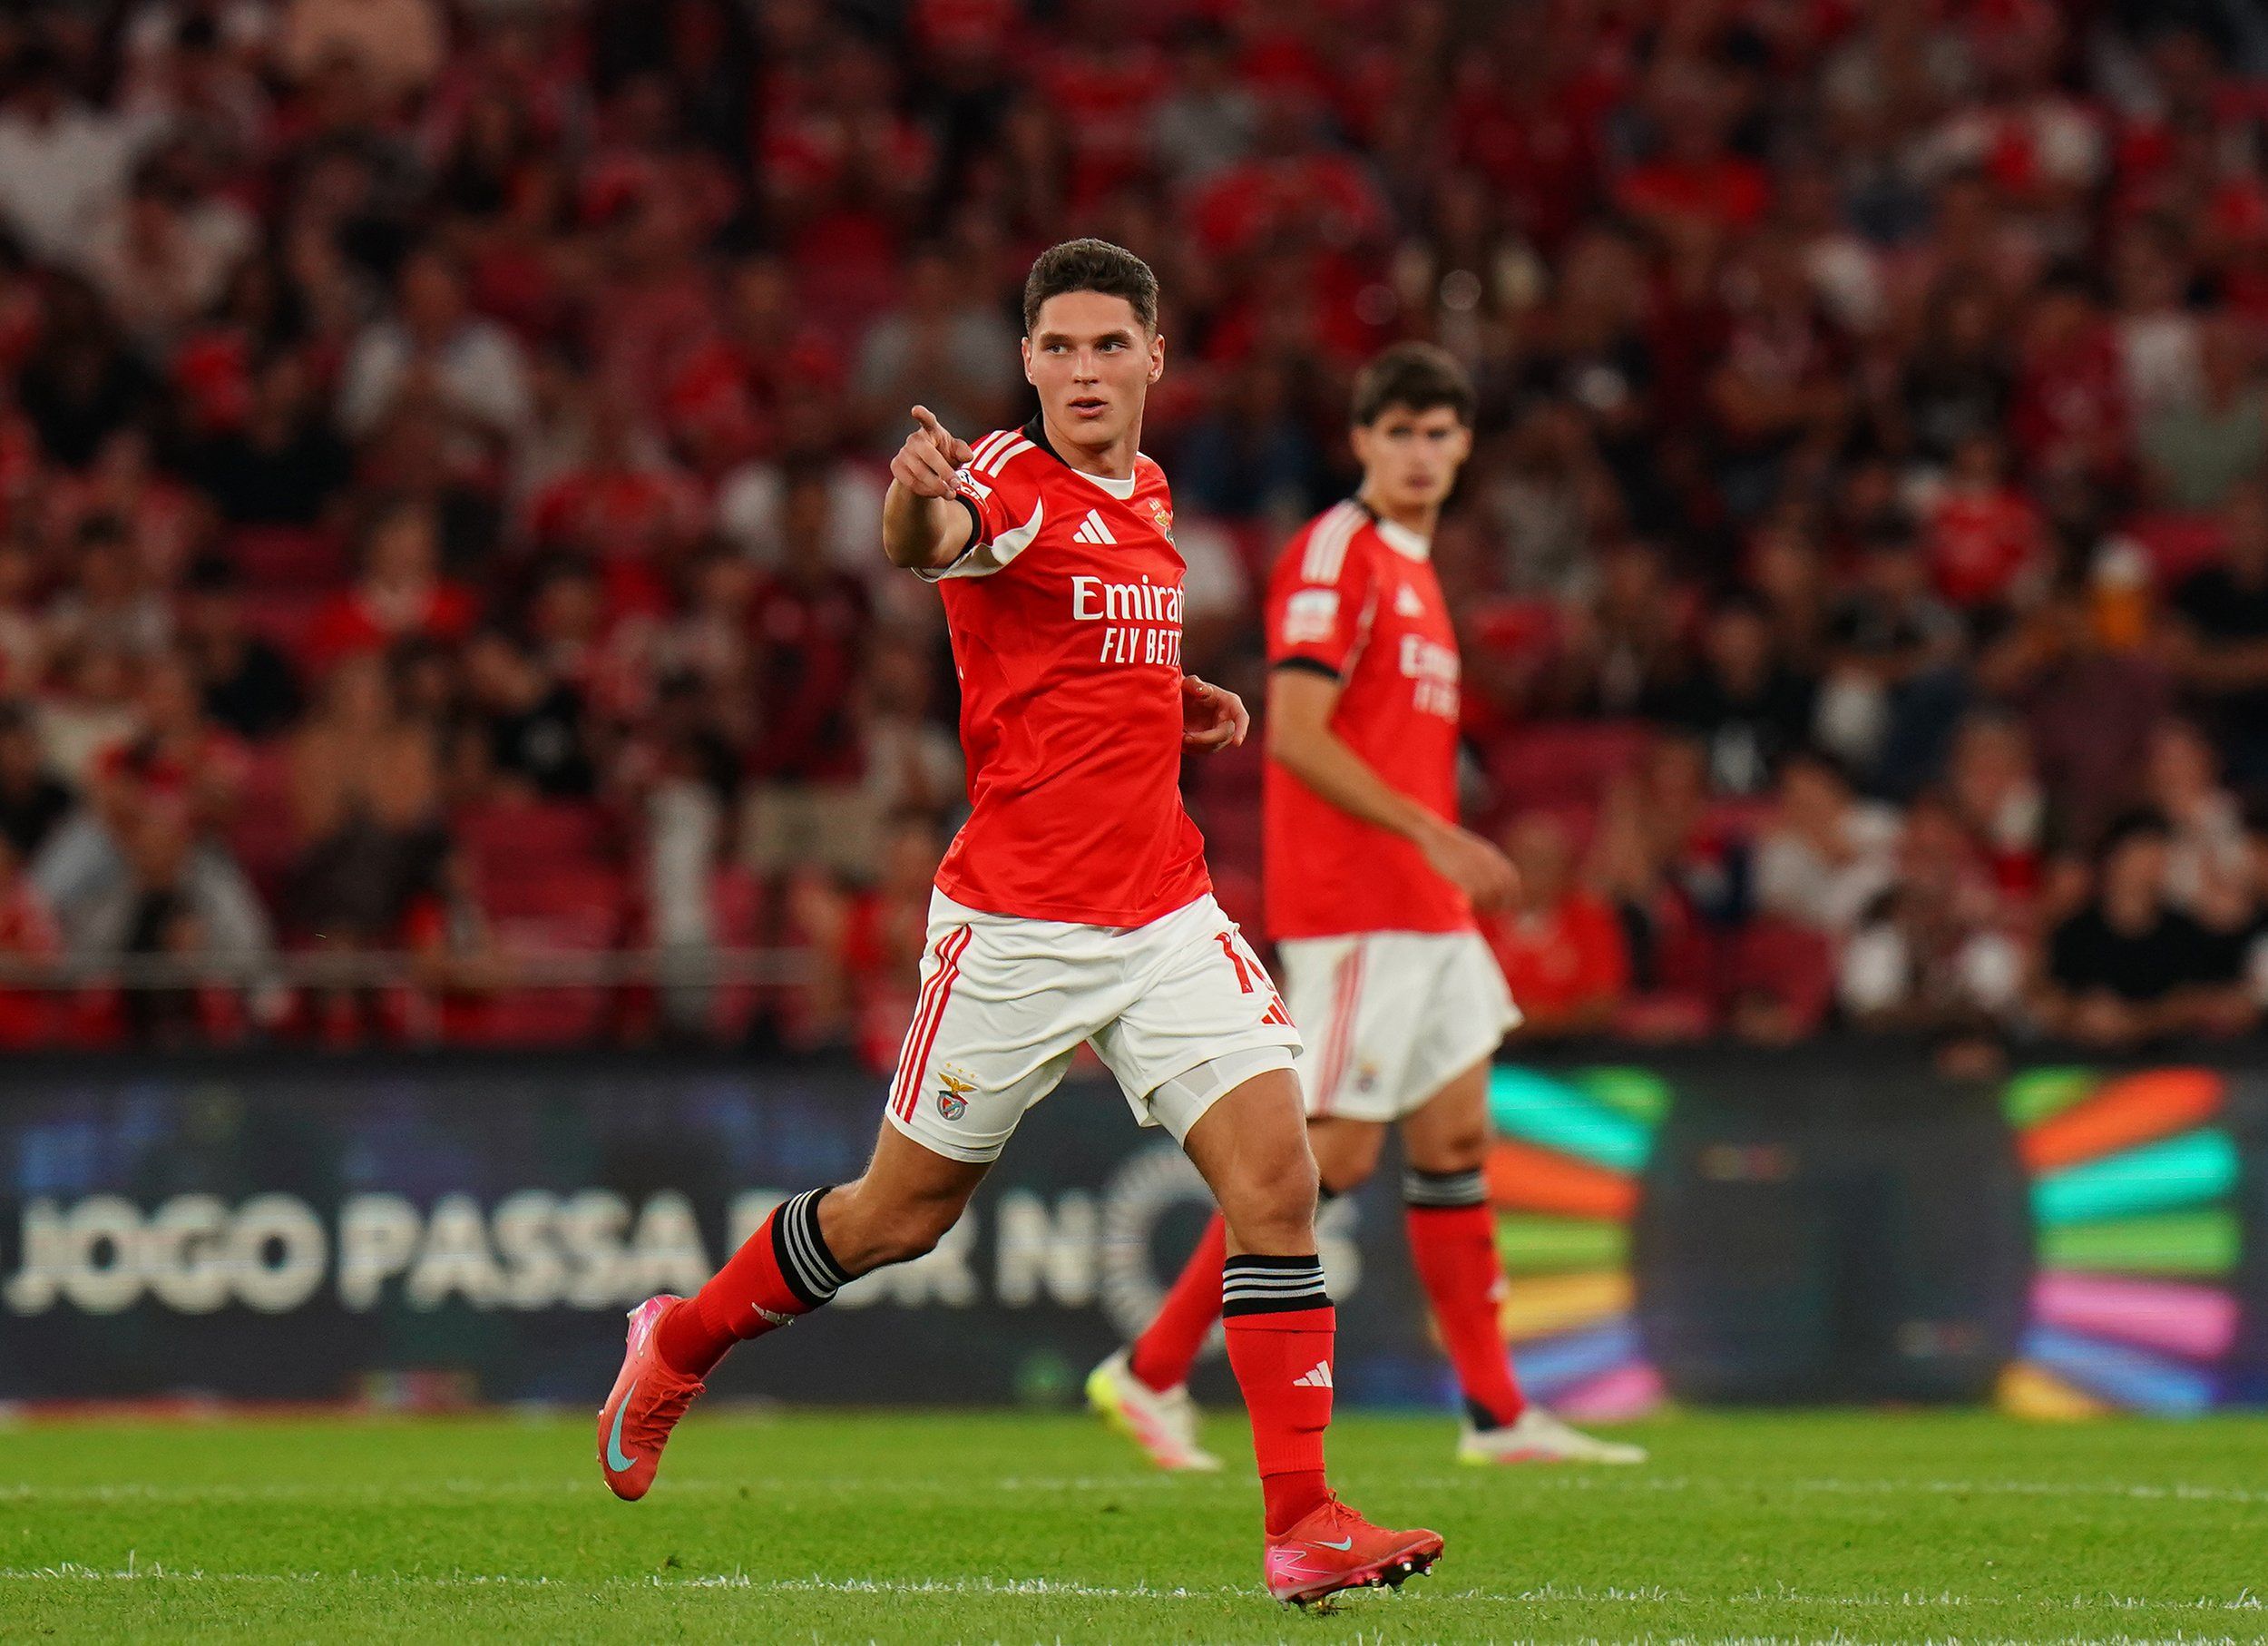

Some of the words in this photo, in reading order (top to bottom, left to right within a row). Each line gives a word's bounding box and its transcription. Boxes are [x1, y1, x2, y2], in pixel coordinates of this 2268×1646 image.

[1100, 627, 1140, 663] FLY
[1214, 931, 1276, 994] 1
[5, 1192, 329, 1313] JOGO
[337, 1189, 710, 1310] PASSA
